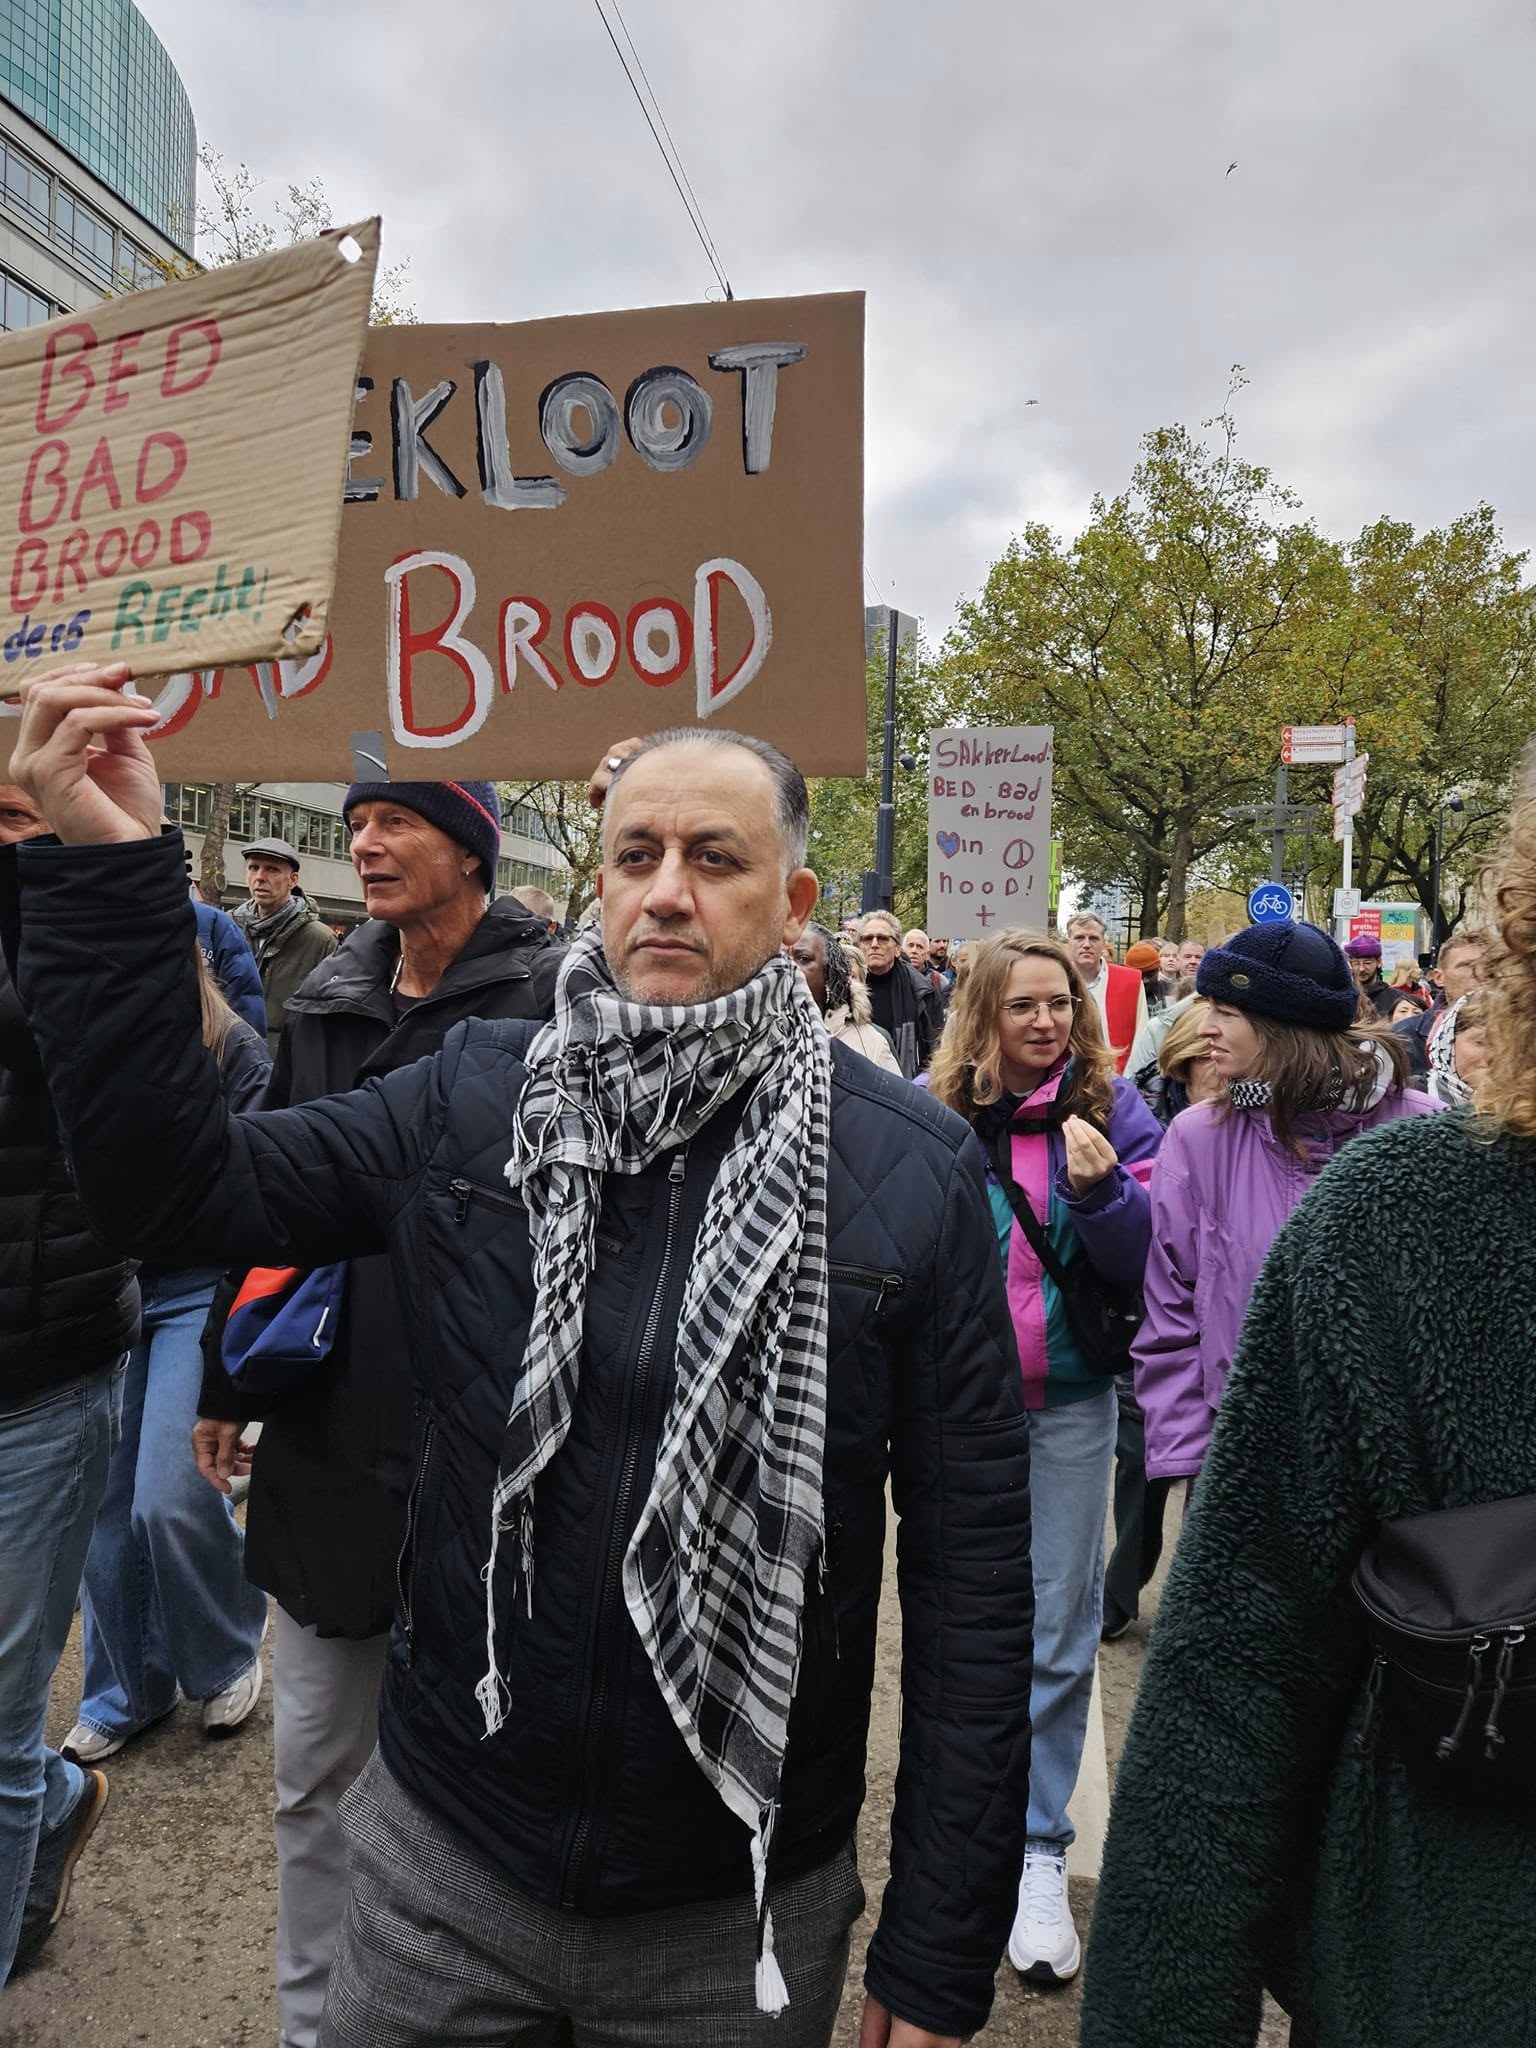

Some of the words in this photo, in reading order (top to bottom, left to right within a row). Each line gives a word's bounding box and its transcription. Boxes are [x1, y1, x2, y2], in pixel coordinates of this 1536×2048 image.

[35, 318, 223, 434] BED
[343, 341, 808, 511] EKLOOT
[18, 431, 188, 534] BAD
[10, 510, 213, 613] BROOD
[4, 609, 92, 663] ders
[385, 549, 773, 749] BROOD
[933, 776, 976, 798] BED
[961, 804, 979, 817] en
[984, 802, 1035, 820] brood
